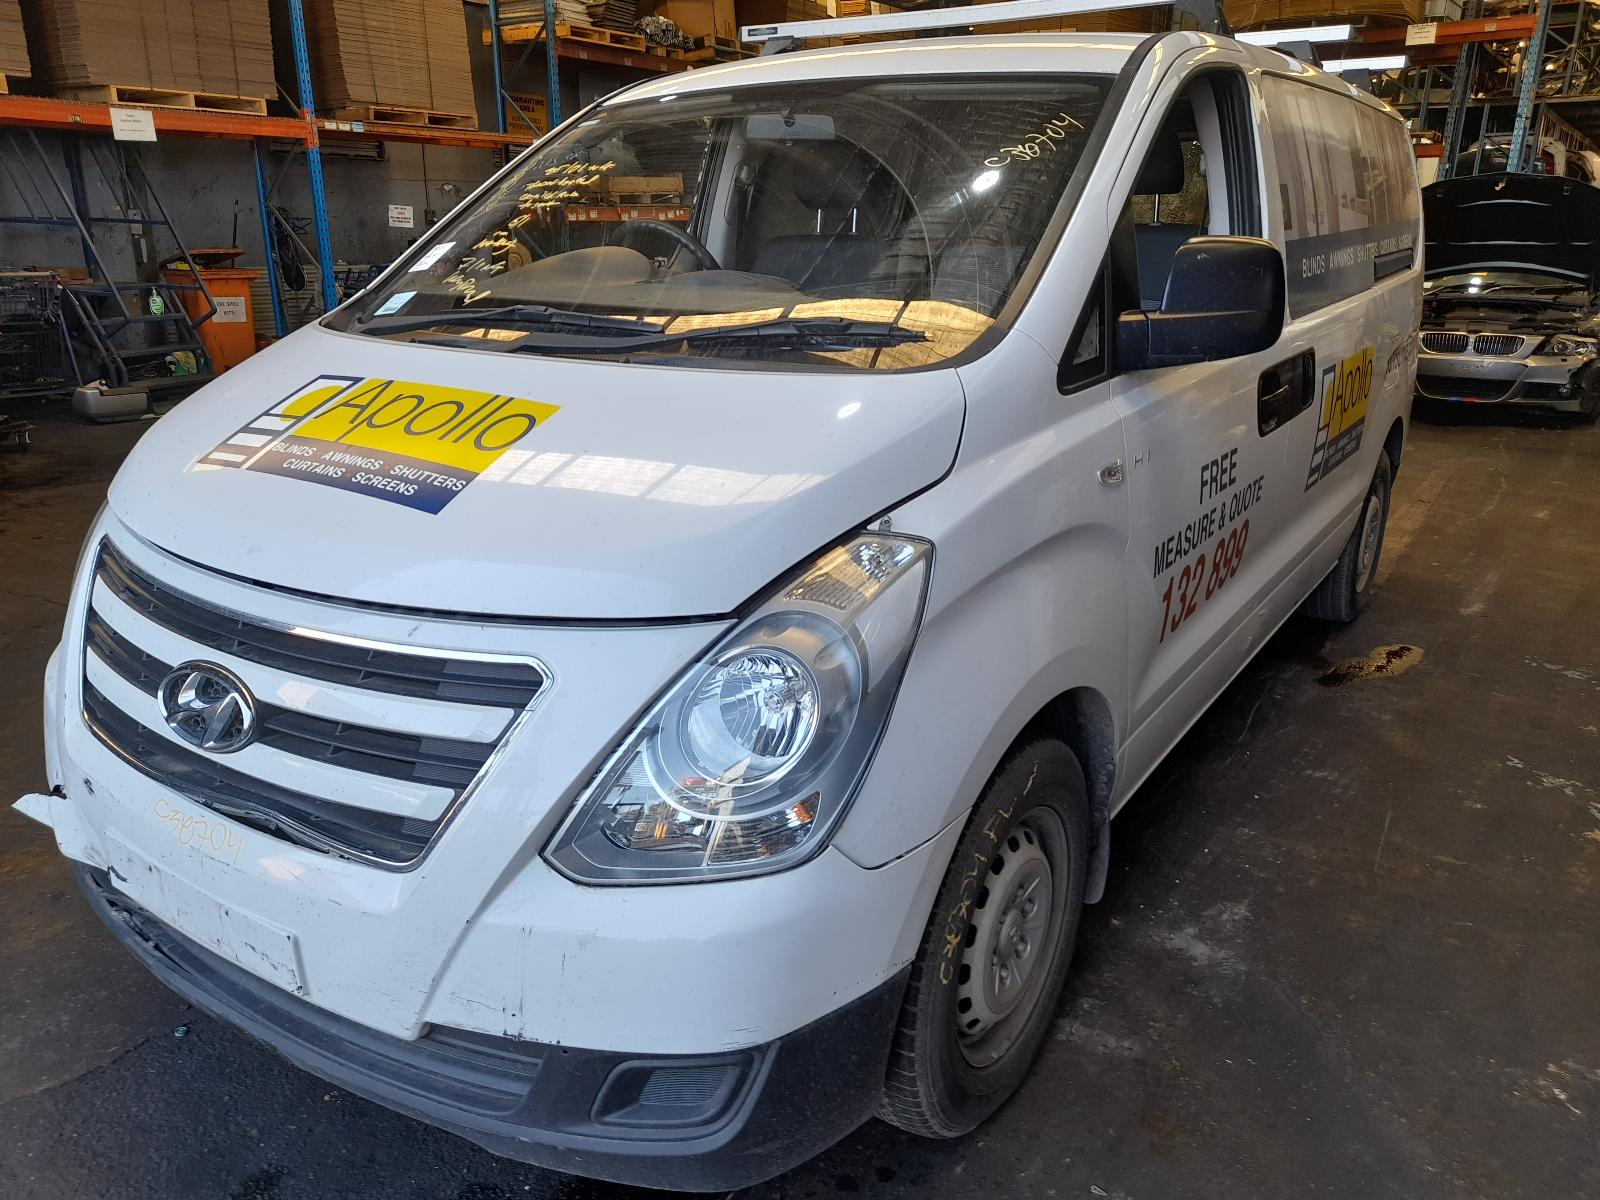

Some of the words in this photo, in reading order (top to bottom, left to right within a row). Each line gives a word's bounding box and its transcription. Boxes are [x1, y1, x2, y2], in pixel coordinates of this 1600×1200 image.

[1302, 254, 1325, 279] BLINDS
[1329, 247, 1354, 271] AWNINGS
[313, 379, 537, 451] Apollo
[1331, 346, 1373, 436] Apollo
[273, 442, 317, 457] BLINDS
[321, 450, 384, 471] AWNINGS
[390, 463, 467, 492] SHUTTERS
[283, 458, 346, 479] CURTAINS
[351, 472, 418, 497] SCREENS
[1199, 447, 1239, 505] FREE
[1153, 507, 1217, 579] MEASURE
[1218, 501, 1227, 531] &
[1229, 474, 1265, 522] QUOTE
[1159, 552, 1206, 644] 132
[1205, 518, 1250, 601] 899
